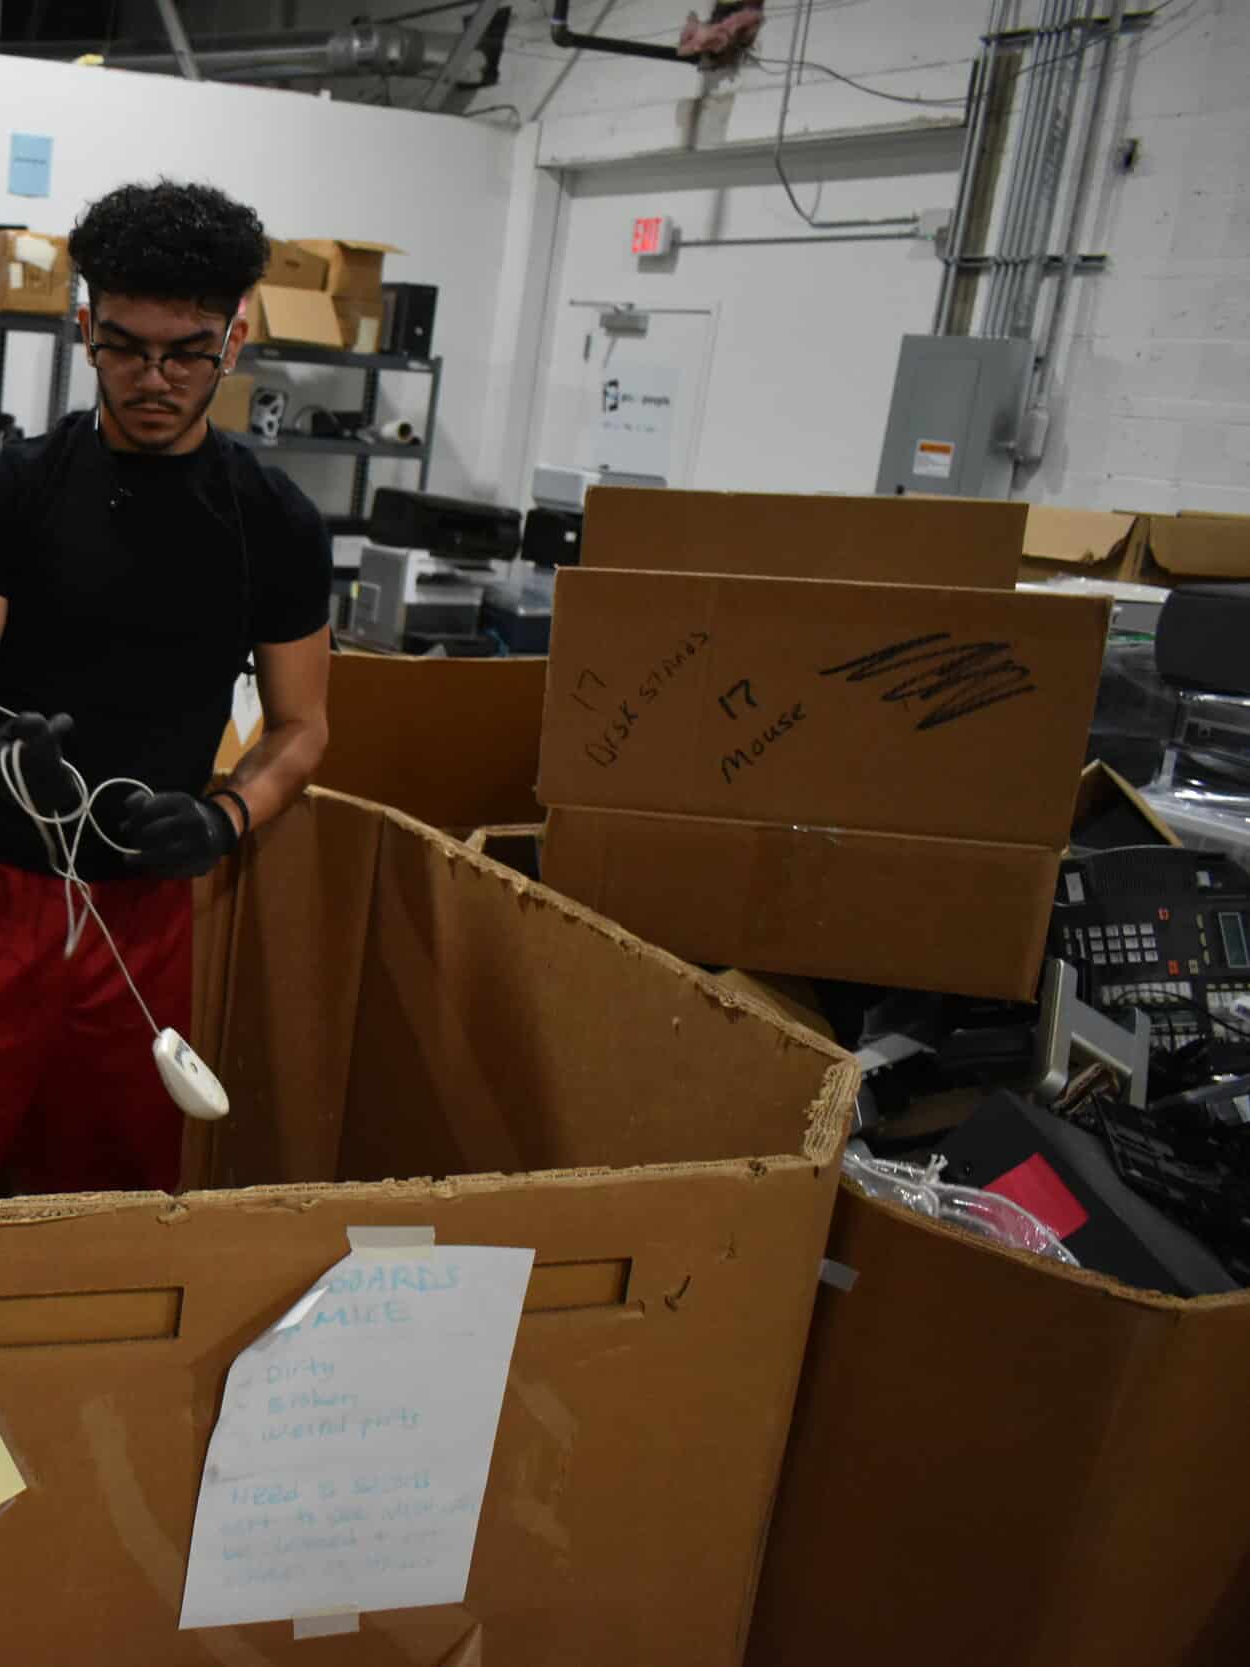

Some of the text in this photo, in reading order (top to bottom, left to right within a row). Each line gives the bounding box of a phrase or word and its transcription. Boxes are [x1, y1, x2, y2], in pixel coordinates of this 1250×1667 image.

[631, 217, 663, 254] EXIT
[570, 669, 607, 711] 17
[718, 679, 759, 720] 17
